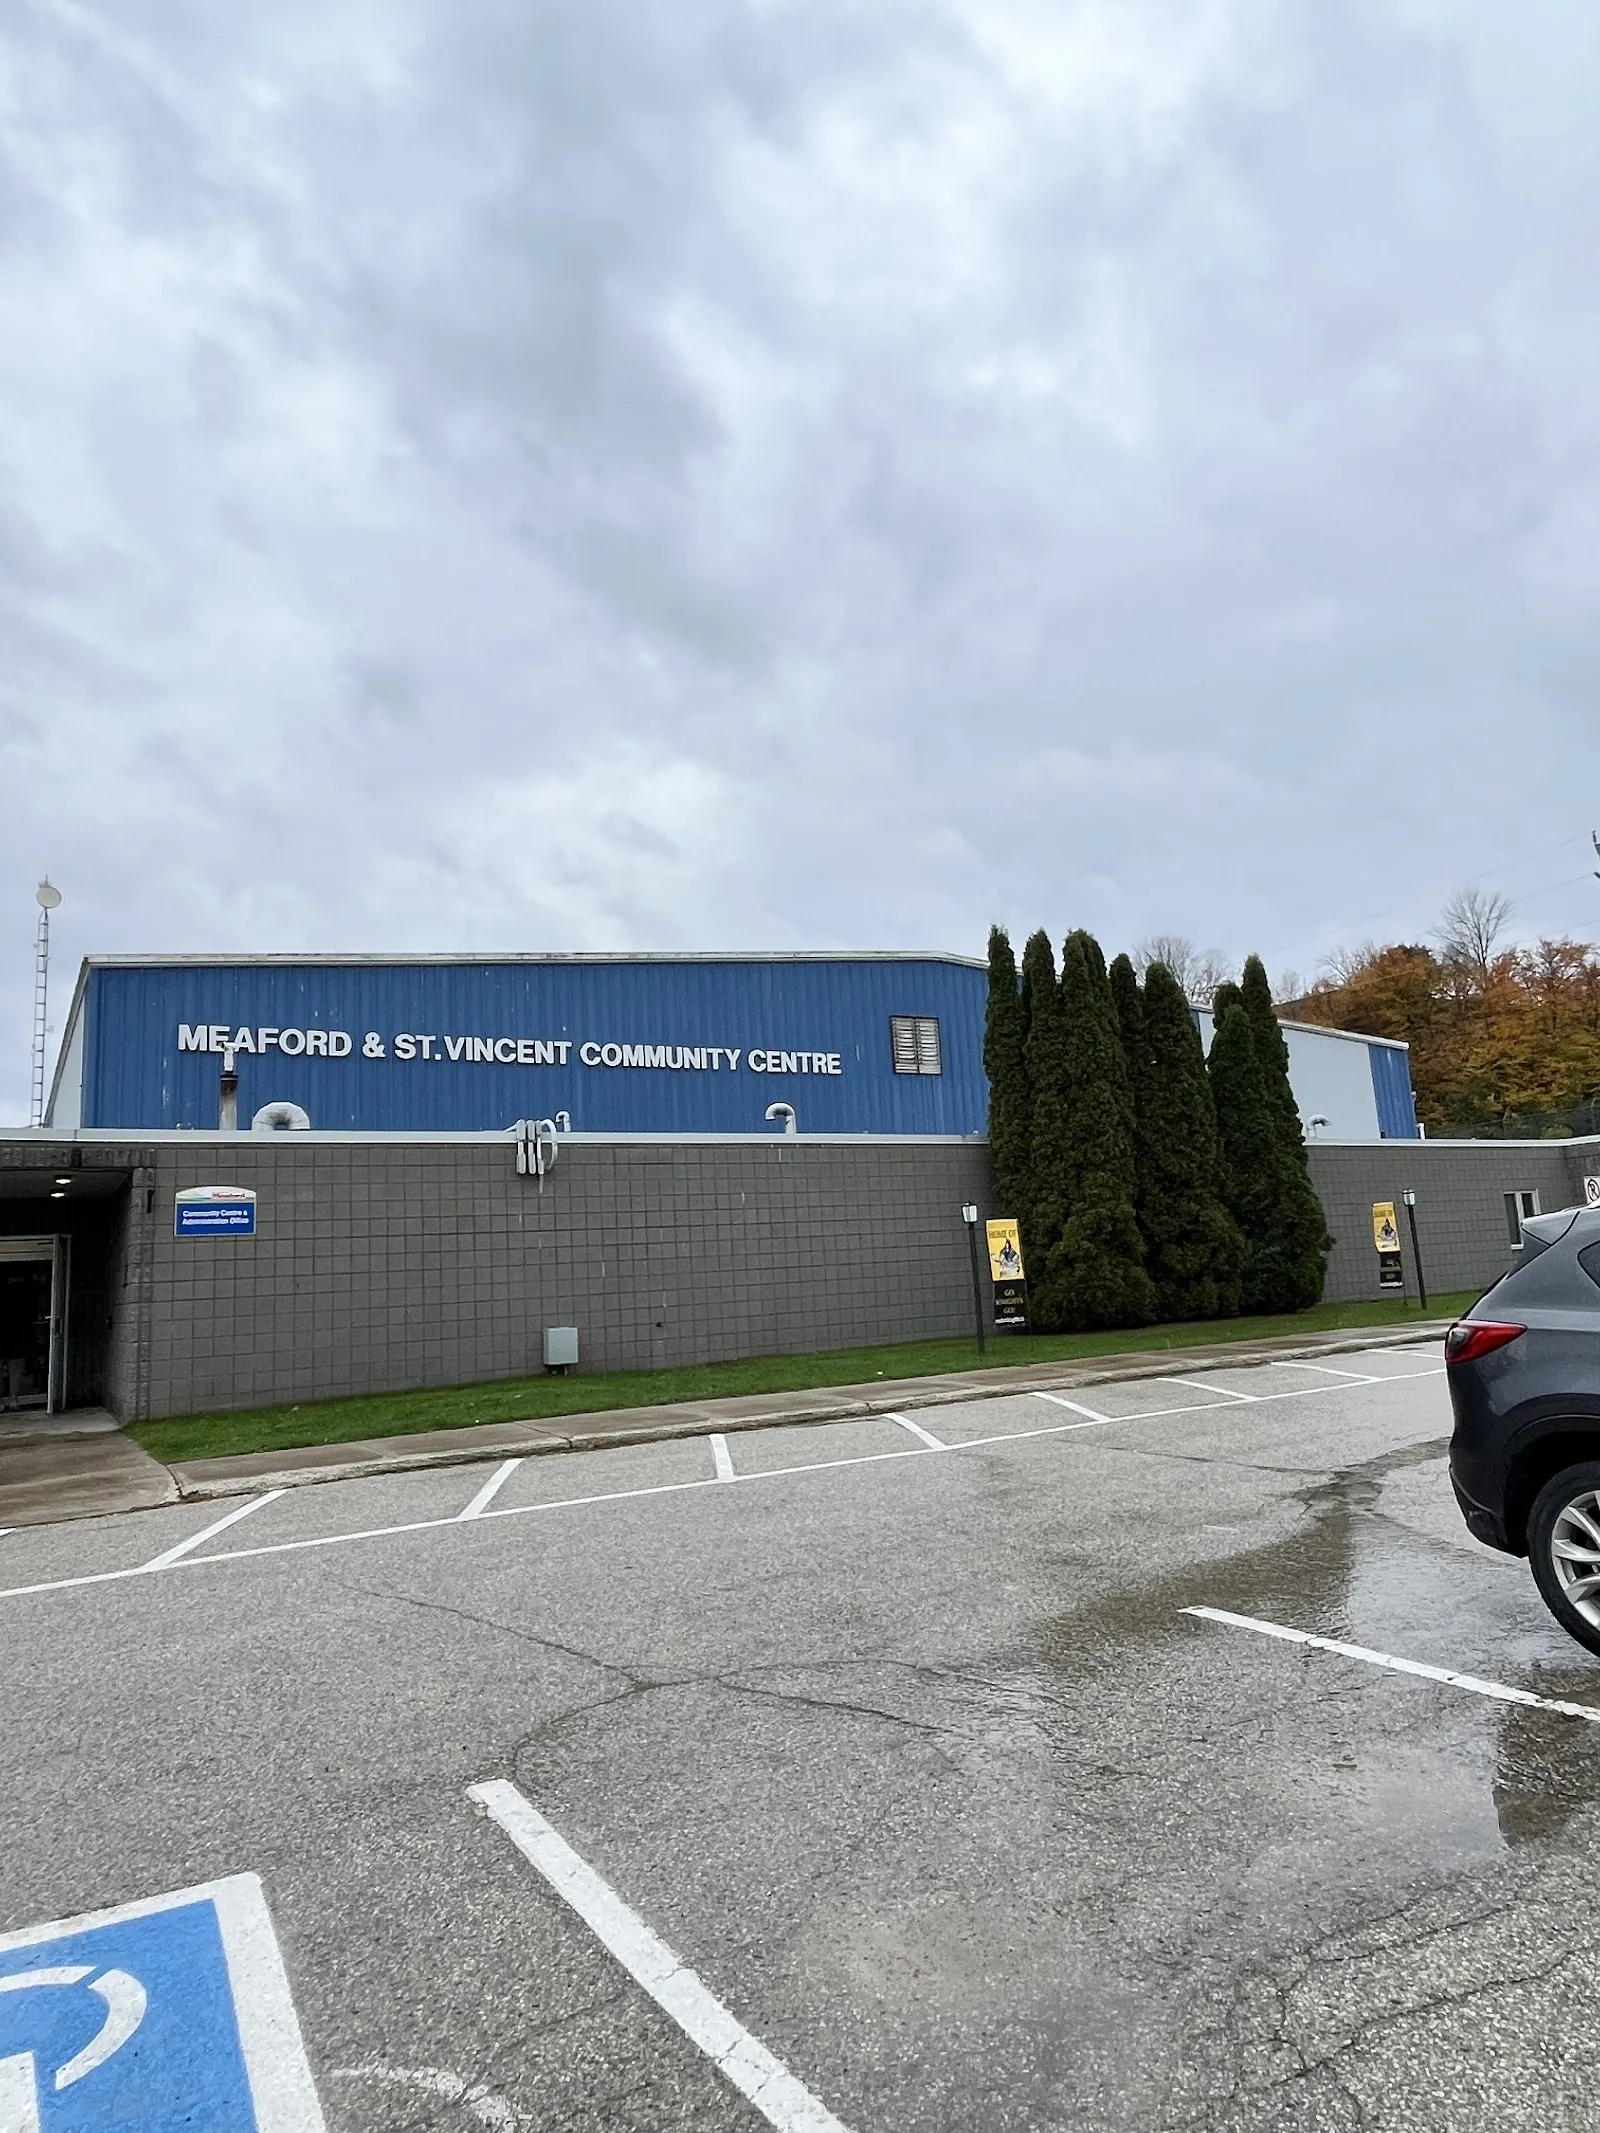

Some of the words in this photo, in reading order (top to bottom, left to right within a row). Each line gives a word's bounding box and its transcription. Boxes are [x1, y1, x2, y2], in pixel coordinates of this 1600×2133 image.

[178, 1024, 352, 1057] MEAFORD
[362, 1031, 386, 1059] &
[579, 1042, 741, 1071] COMMUNITY
[748, 1049, 842, 1075] CENTRE
